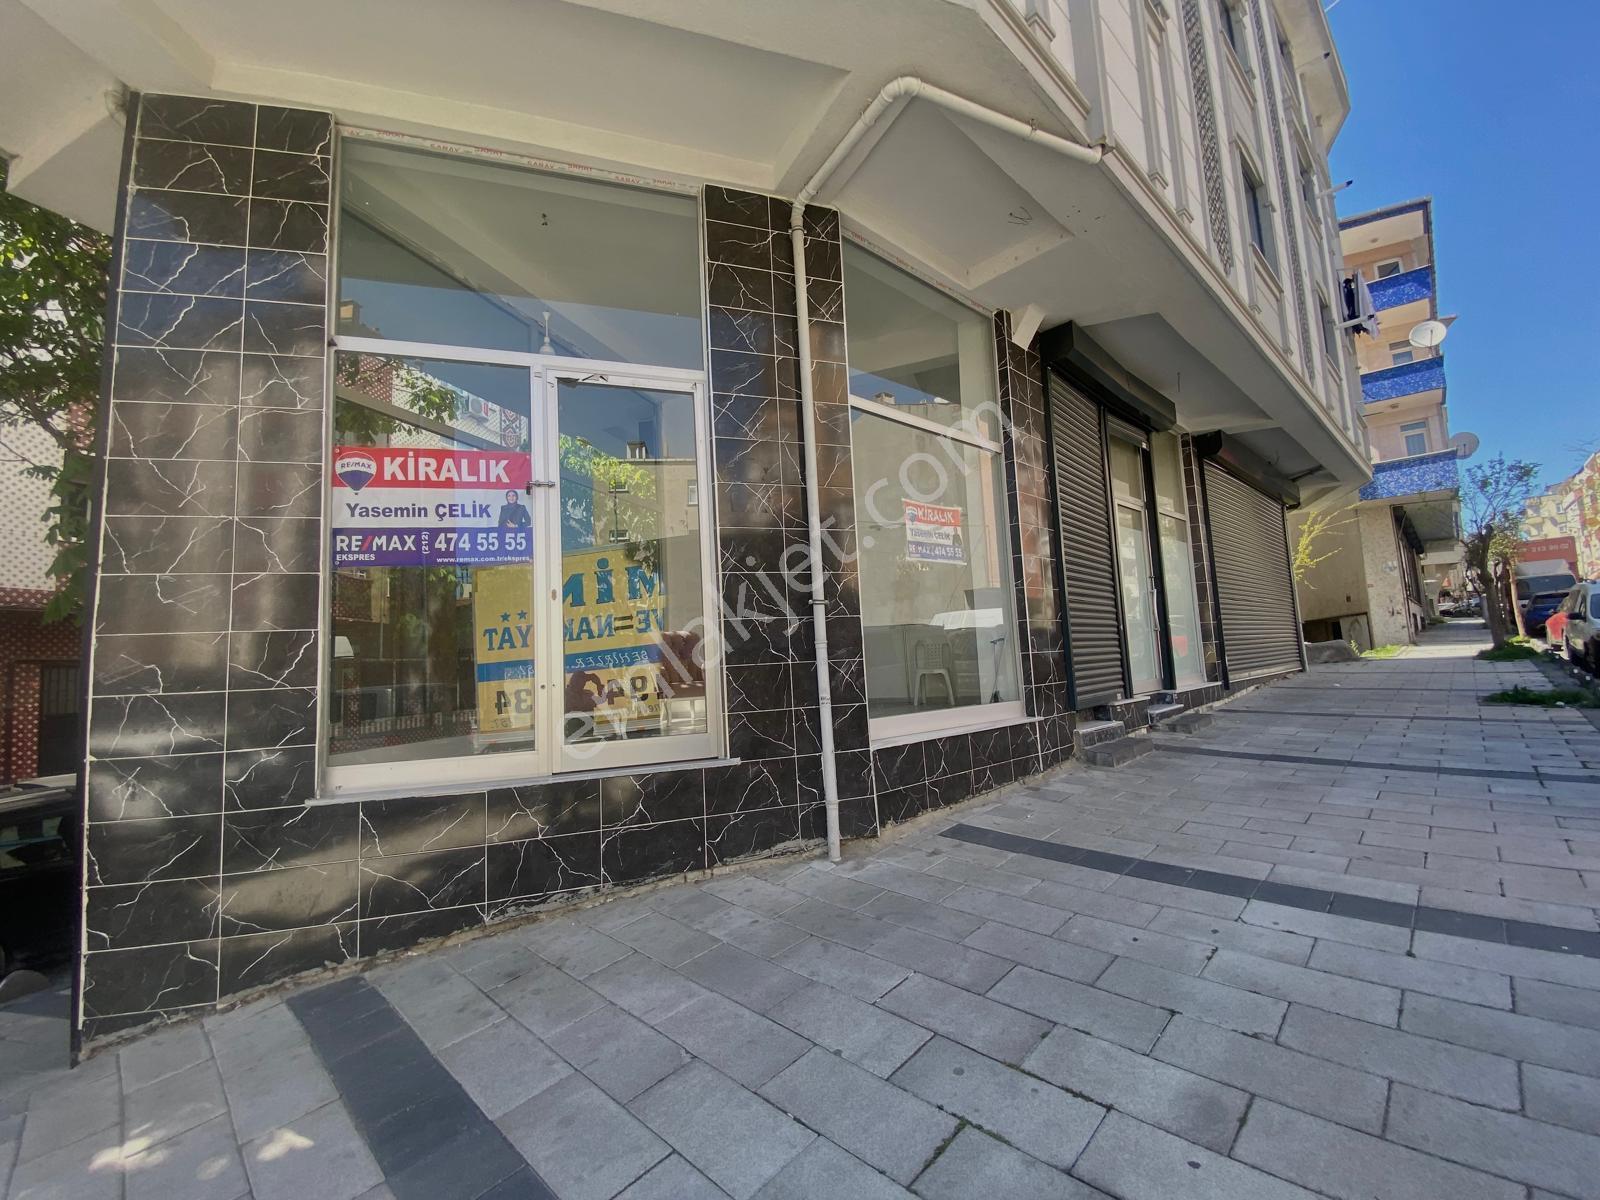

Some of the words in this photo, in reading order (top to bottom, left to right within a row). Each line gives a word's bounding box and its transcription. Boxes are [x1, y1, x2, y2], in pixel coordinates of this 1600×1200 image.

[340, 461, 372, 470] RE/MAX
[383, 451, 510, 483] KİRALIK
[346, 503, 429, 518] Yasemin
[434, 500, 492, 521] ÇELİK
[336, 535, 417, 551] RE/MAX
[434, 532, 471, 551] 474
[476, 532, 499, 551] 55
[504, 532, 527, 551] 55
[336, 553, 376, 561] EKSPRES
